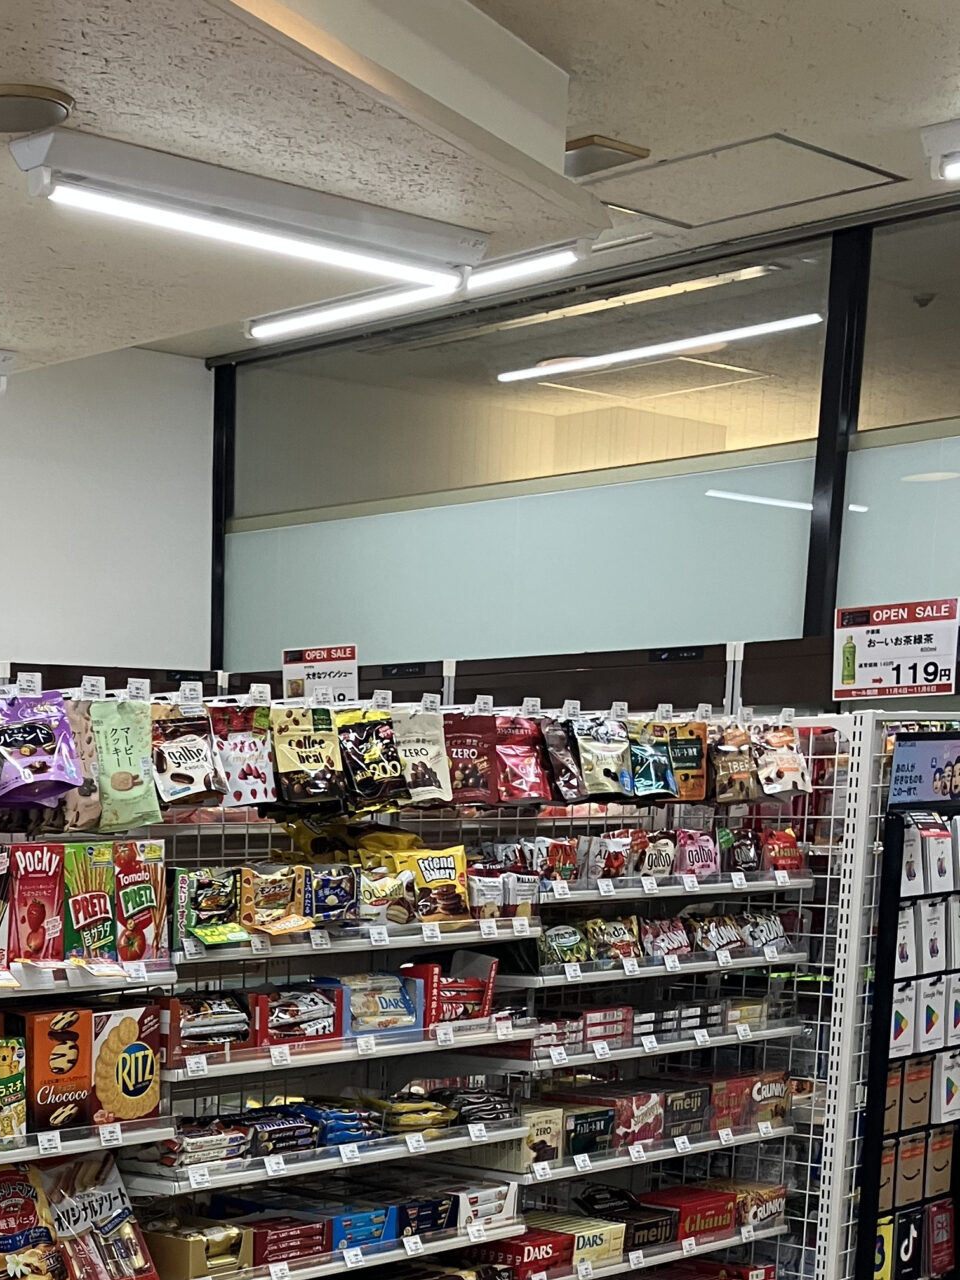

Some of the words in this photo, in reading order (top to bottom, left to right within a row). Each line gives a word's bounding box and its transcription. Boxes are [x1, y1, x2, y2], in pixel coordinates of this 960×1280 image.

[873, 608, 908, 622] OPEN
[915, 604, 950, 618] SALE
[305, 650, 328, 660] OPEN
[331, 648, 352, 658] SALE
[891, 661, 952, 685] 119円
[402, 748, 429, 758] ZERO
[451, 748, 478, 759] ZERO
[417, 855, 455, 871] Friend
[646, 849, 671, 871] galbo
[687, 846, 714, 867] galbo
[118, 870, 150, 886] Tomato
[423, 865, 457, 884] Bakery
[121, 885, 155, 914] PRETZ
[72, 894, 110, 929] PRETZ
[117, 1049, 153, 1091] RITZ
[37, 1086, 88, 1105] Chococo
[751, 1081, 789, 1102] CRUNKY
[672, 1092, 702, 1111] meiji
[535, 1126, 552, 1137] ZERO
[748, 1200, 785, 1224] CRUNKY
[684, 1211, 732, 1233] Ghana
[576, 1233, 604, 1250] DARS
[634, 1219, 672, 1248] meiji
[523, 1244, 553, 1261] DARS
